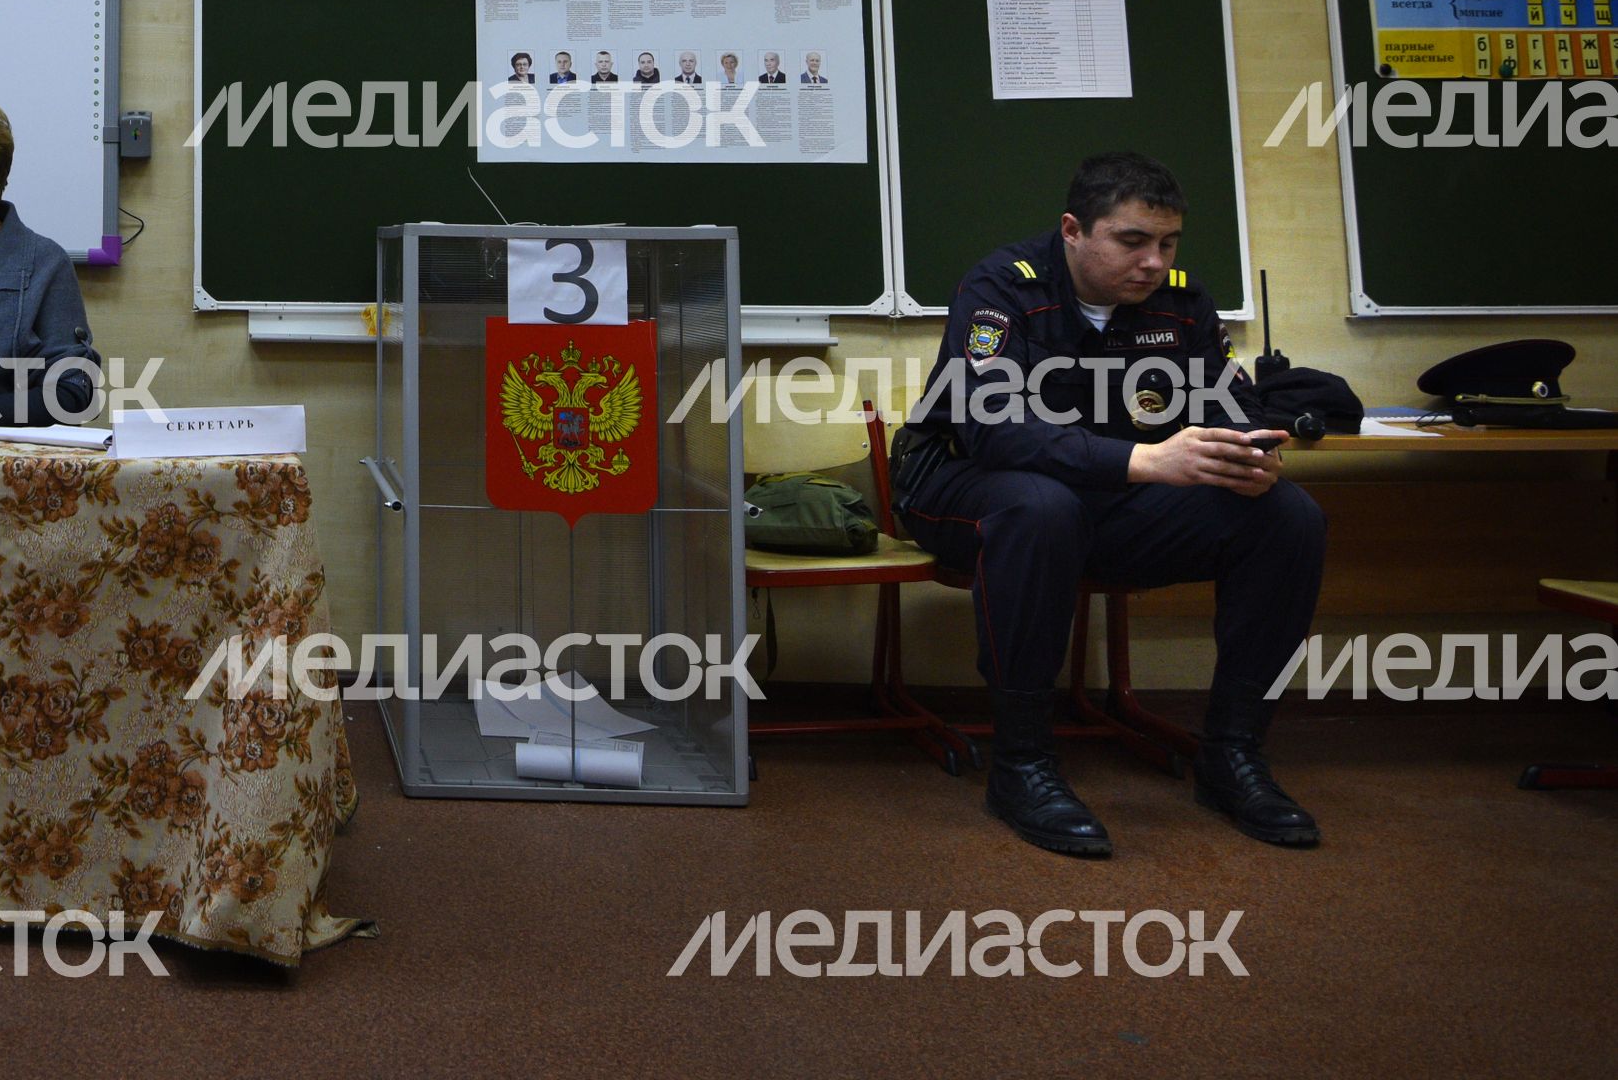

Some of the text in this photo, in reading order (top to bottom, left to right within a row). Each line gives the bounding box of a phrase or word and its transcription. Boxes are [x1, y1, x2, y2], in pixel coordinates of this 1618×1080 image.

[1391, 0, 1433, 9] всегда
[1459, 9, 1504, 17] мягкие
[1385, 43, 1435, 53] парные
[1385, 54, 1455, 63] согласные
[544, 238, 599, 324] 3
[975, 310, 1008, 323] ПОЛИЦИЯ
[166, 420, 254, 431] СЕКРЕТАРЬ
